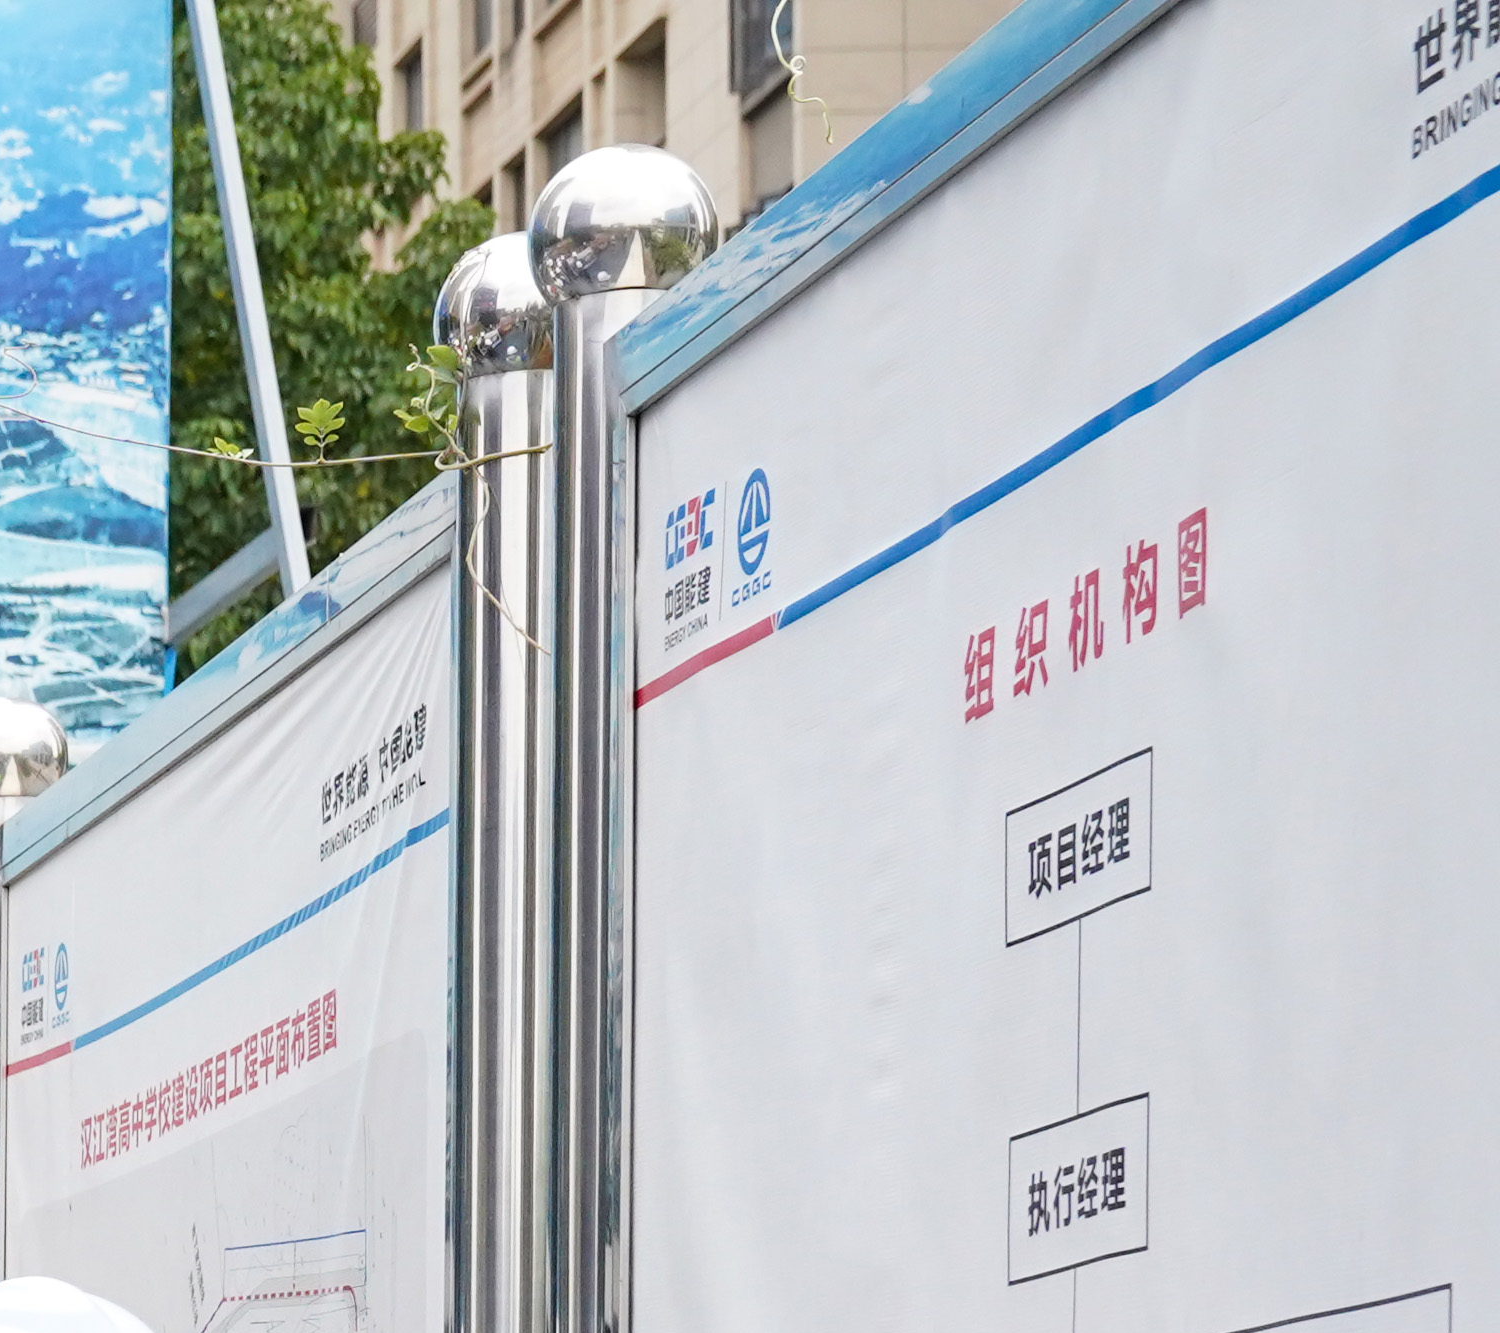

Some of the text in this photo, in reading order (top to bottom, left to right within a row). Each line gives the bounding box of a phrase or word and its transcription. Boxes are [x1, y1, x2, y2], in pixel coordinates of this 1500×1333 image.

[1413, 0, 1500, 95] 世界
[665, 565, 711, 625] 中国能建
[687, 613, 708, 638] CHINA
[731, 570, 772, 607] CGGC
[964, 506, 1209, 724] 组织机构图
[1028, 797, 1131, 900] 项目经理
[81, 989, 337, 1169] 汉江湾高中学校建设项目工程平面布置图
[1028, 1146, 1126, 1237] 执行经理
